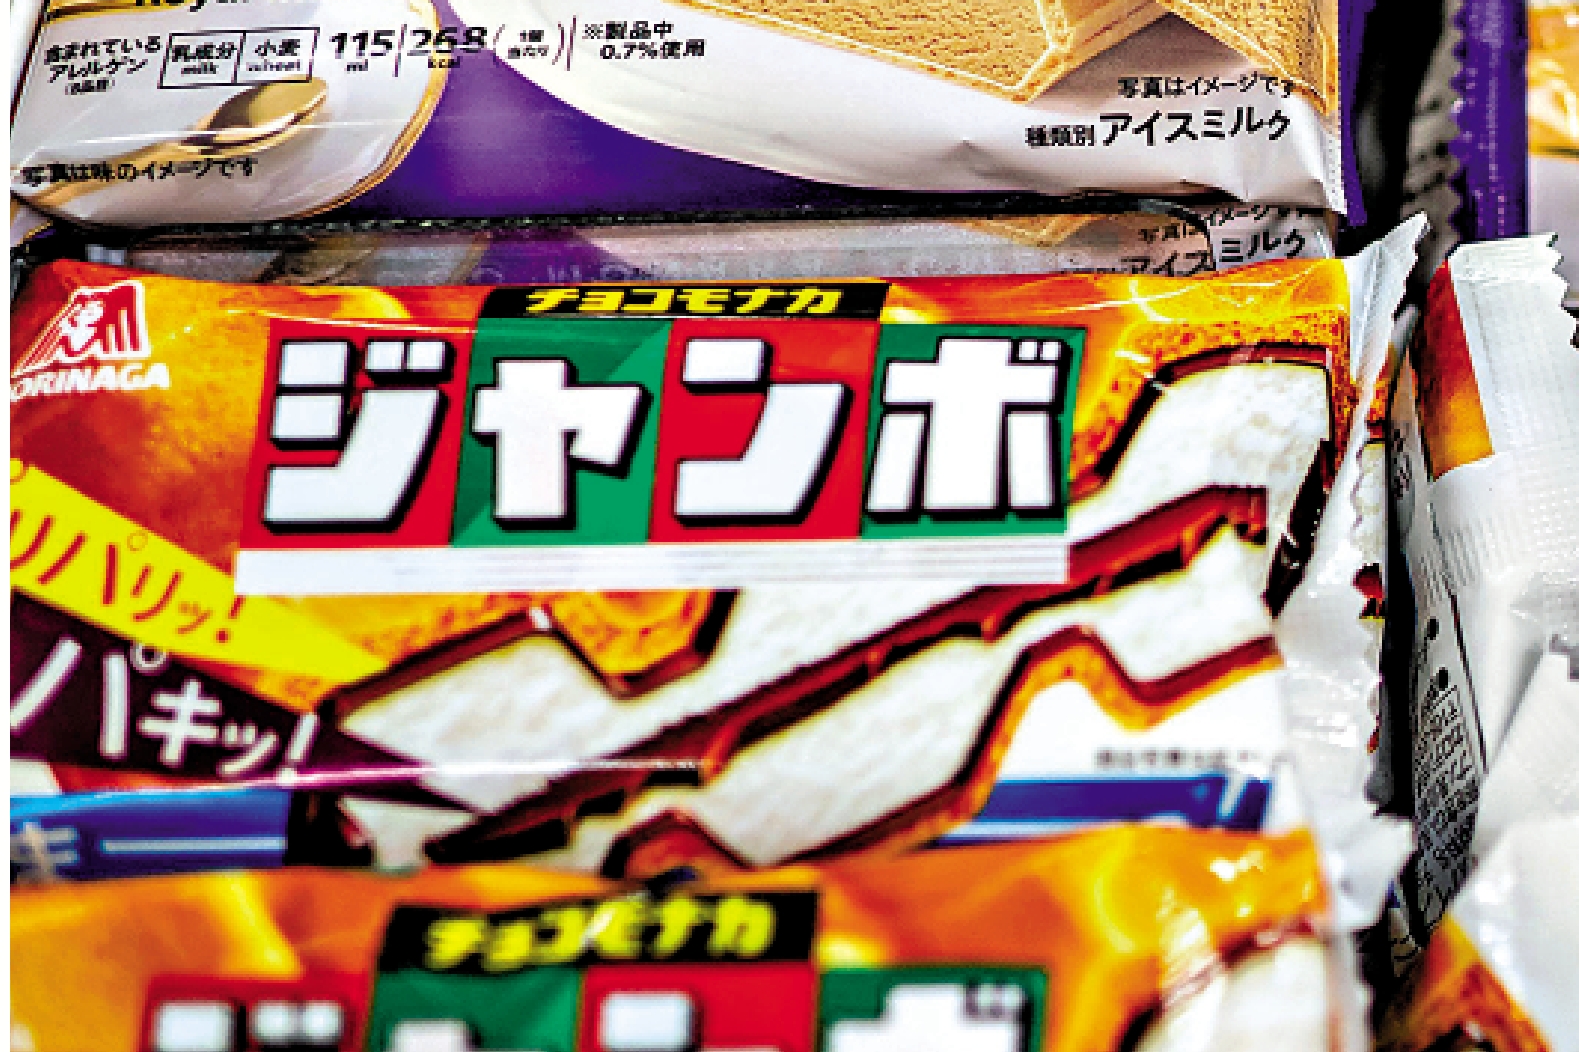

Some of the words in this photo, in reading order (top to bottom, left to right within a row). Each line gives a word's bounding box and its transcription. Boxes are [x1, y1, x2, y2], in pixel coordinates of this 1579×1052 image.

[329, 29, 397, 60] 115
[406, 25, 488, 57] 268
[599, 38, 706, 61] 0.7%使用
[1099, 106, 1291, 147] アイスミルク
[525, 286, 844, 315] チョコモナカ
[262, 334, 1074, 532] ジャンボ
